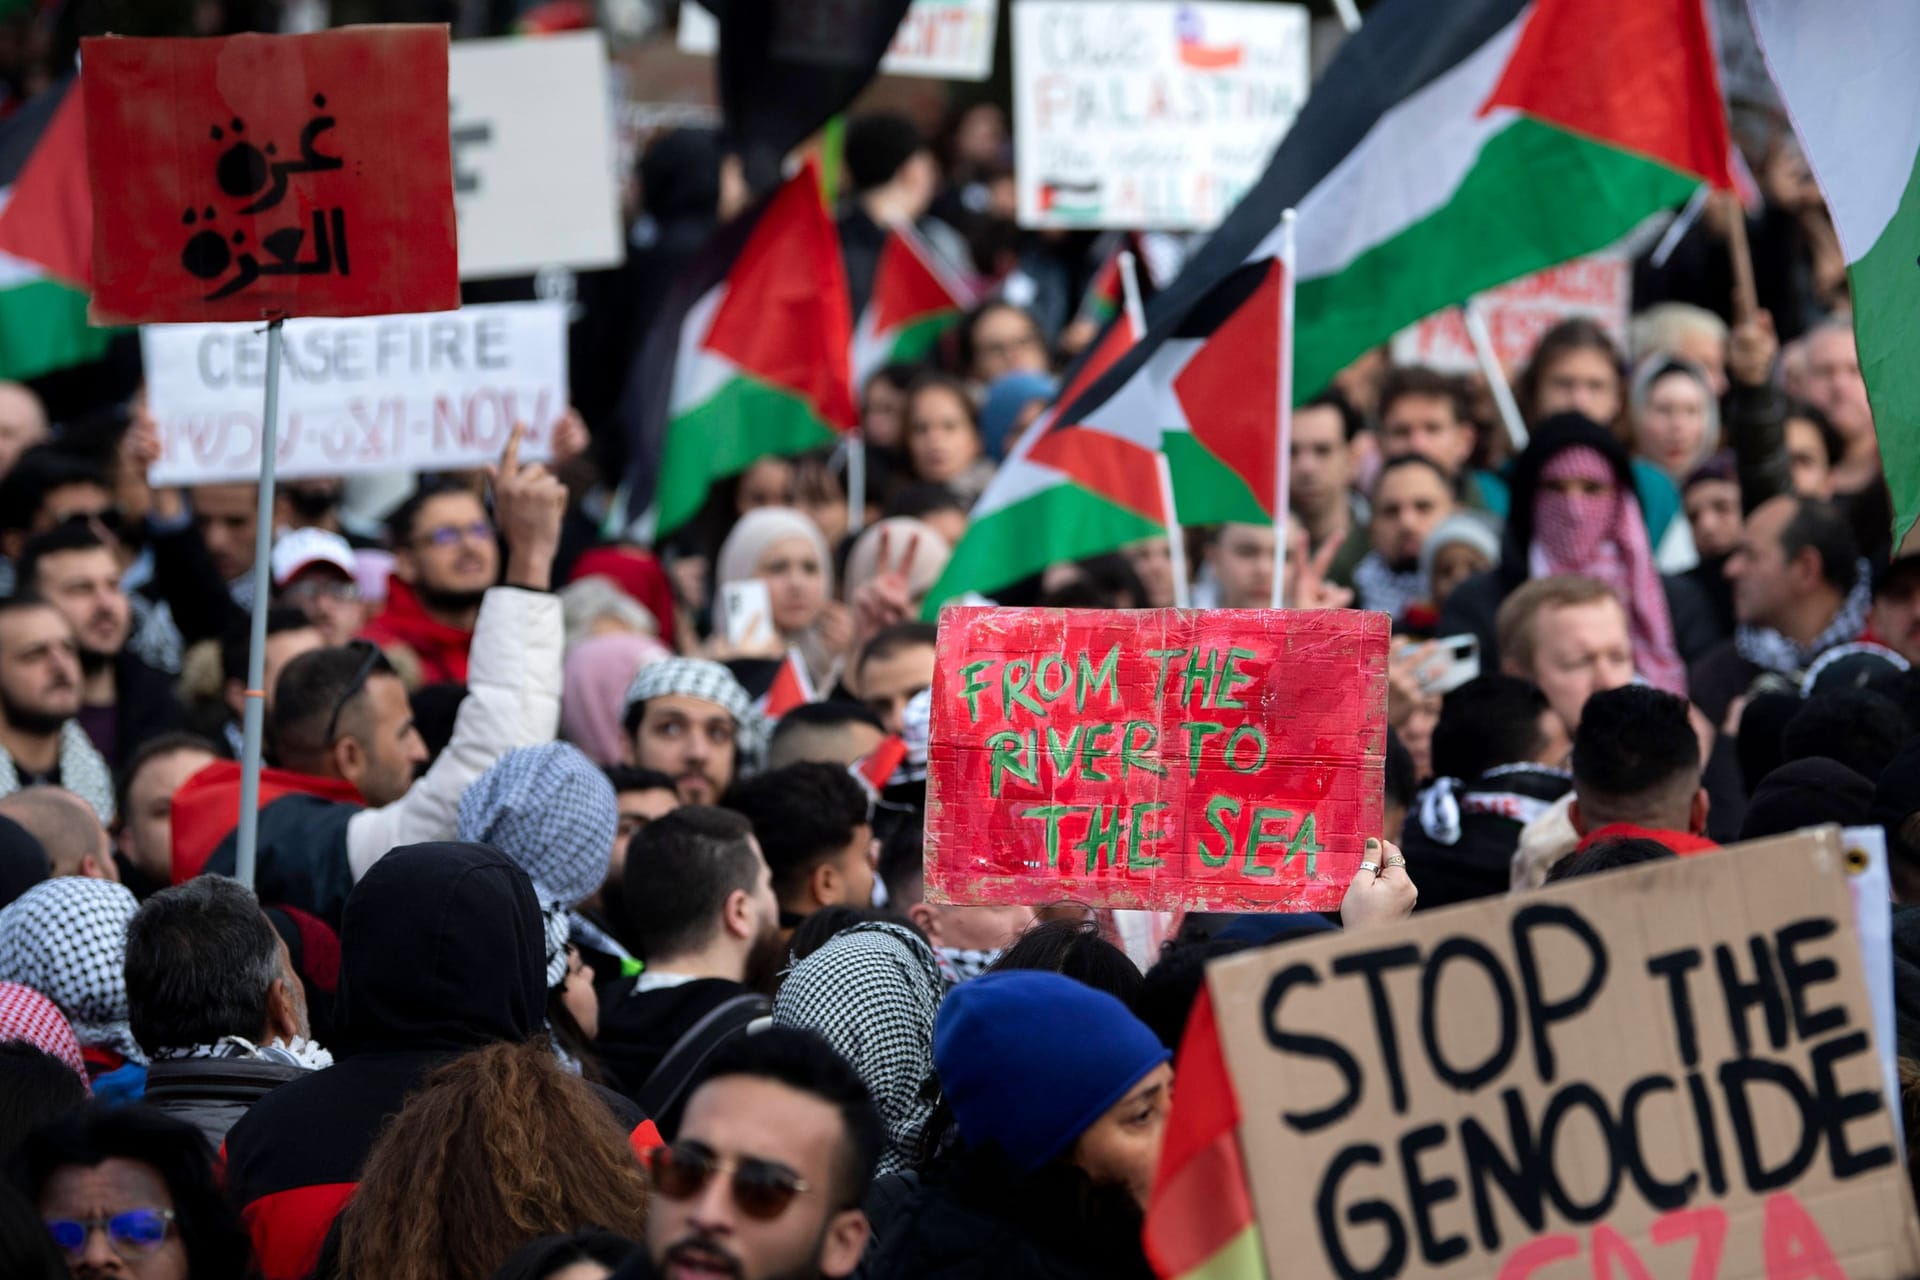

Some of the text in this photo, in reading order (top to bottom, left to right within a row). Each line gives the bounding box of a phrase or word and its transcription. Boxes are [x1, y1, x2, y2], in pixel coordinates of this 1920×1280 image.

[209, 92, 343, 216] غزة
[181, 205, 350, 302] العزة
[197, 317, 512, 389] CEASEFIRE
[958, 644, 1256, 722] FROM THE
[985, 720, 1267, 798] RIVER TO
[1021, 796, 1325, 879] THE SEA
[1260, 903, 1849, 1133] STOP THE
[1315, 1030, 1896, 1280] GENOCIDE
